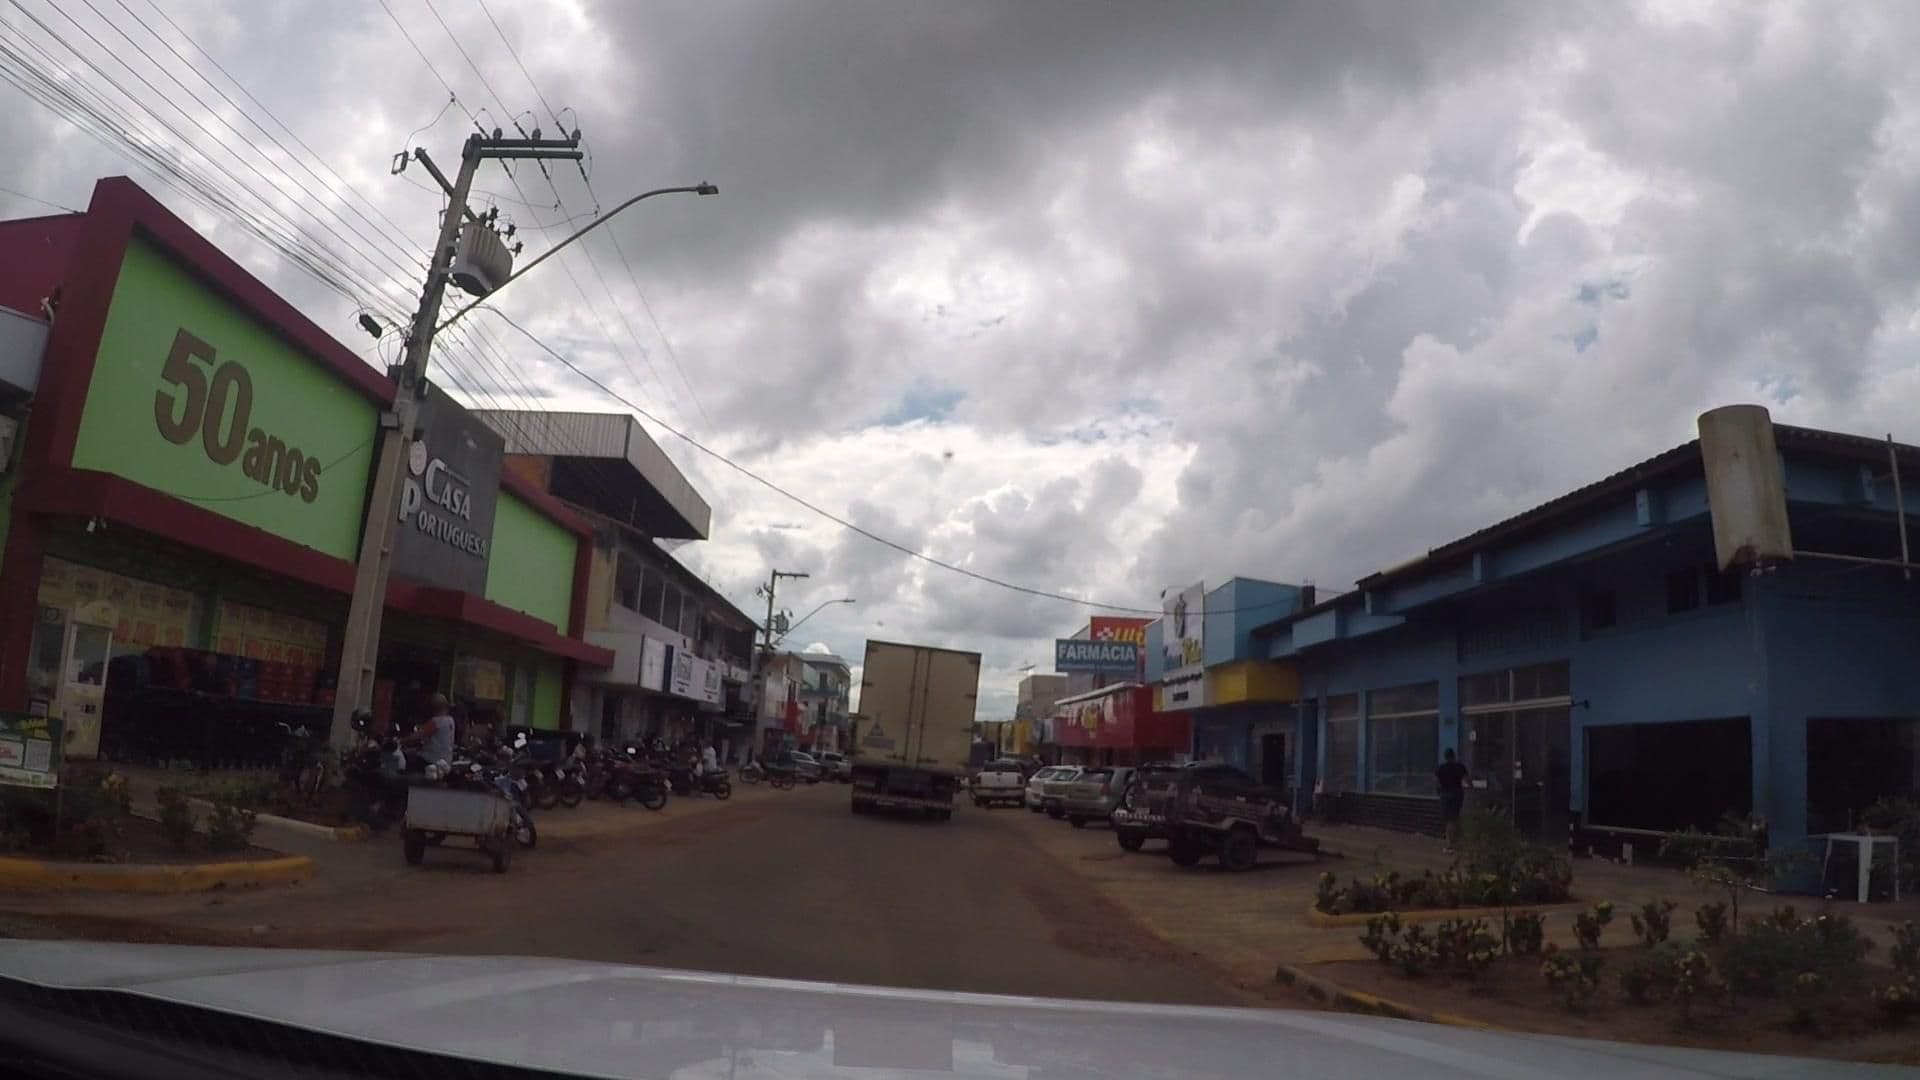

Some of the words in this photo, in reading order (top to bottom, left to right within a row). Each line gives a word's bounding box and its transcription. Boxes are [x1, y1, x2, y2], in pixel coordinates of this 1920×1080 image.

[155, 327, 253, 465] 50
[243, 427, 321, 503] anos
[399, 477, 487, 559] PORTUGUESA
[425, 458, 470, 521] CASA
